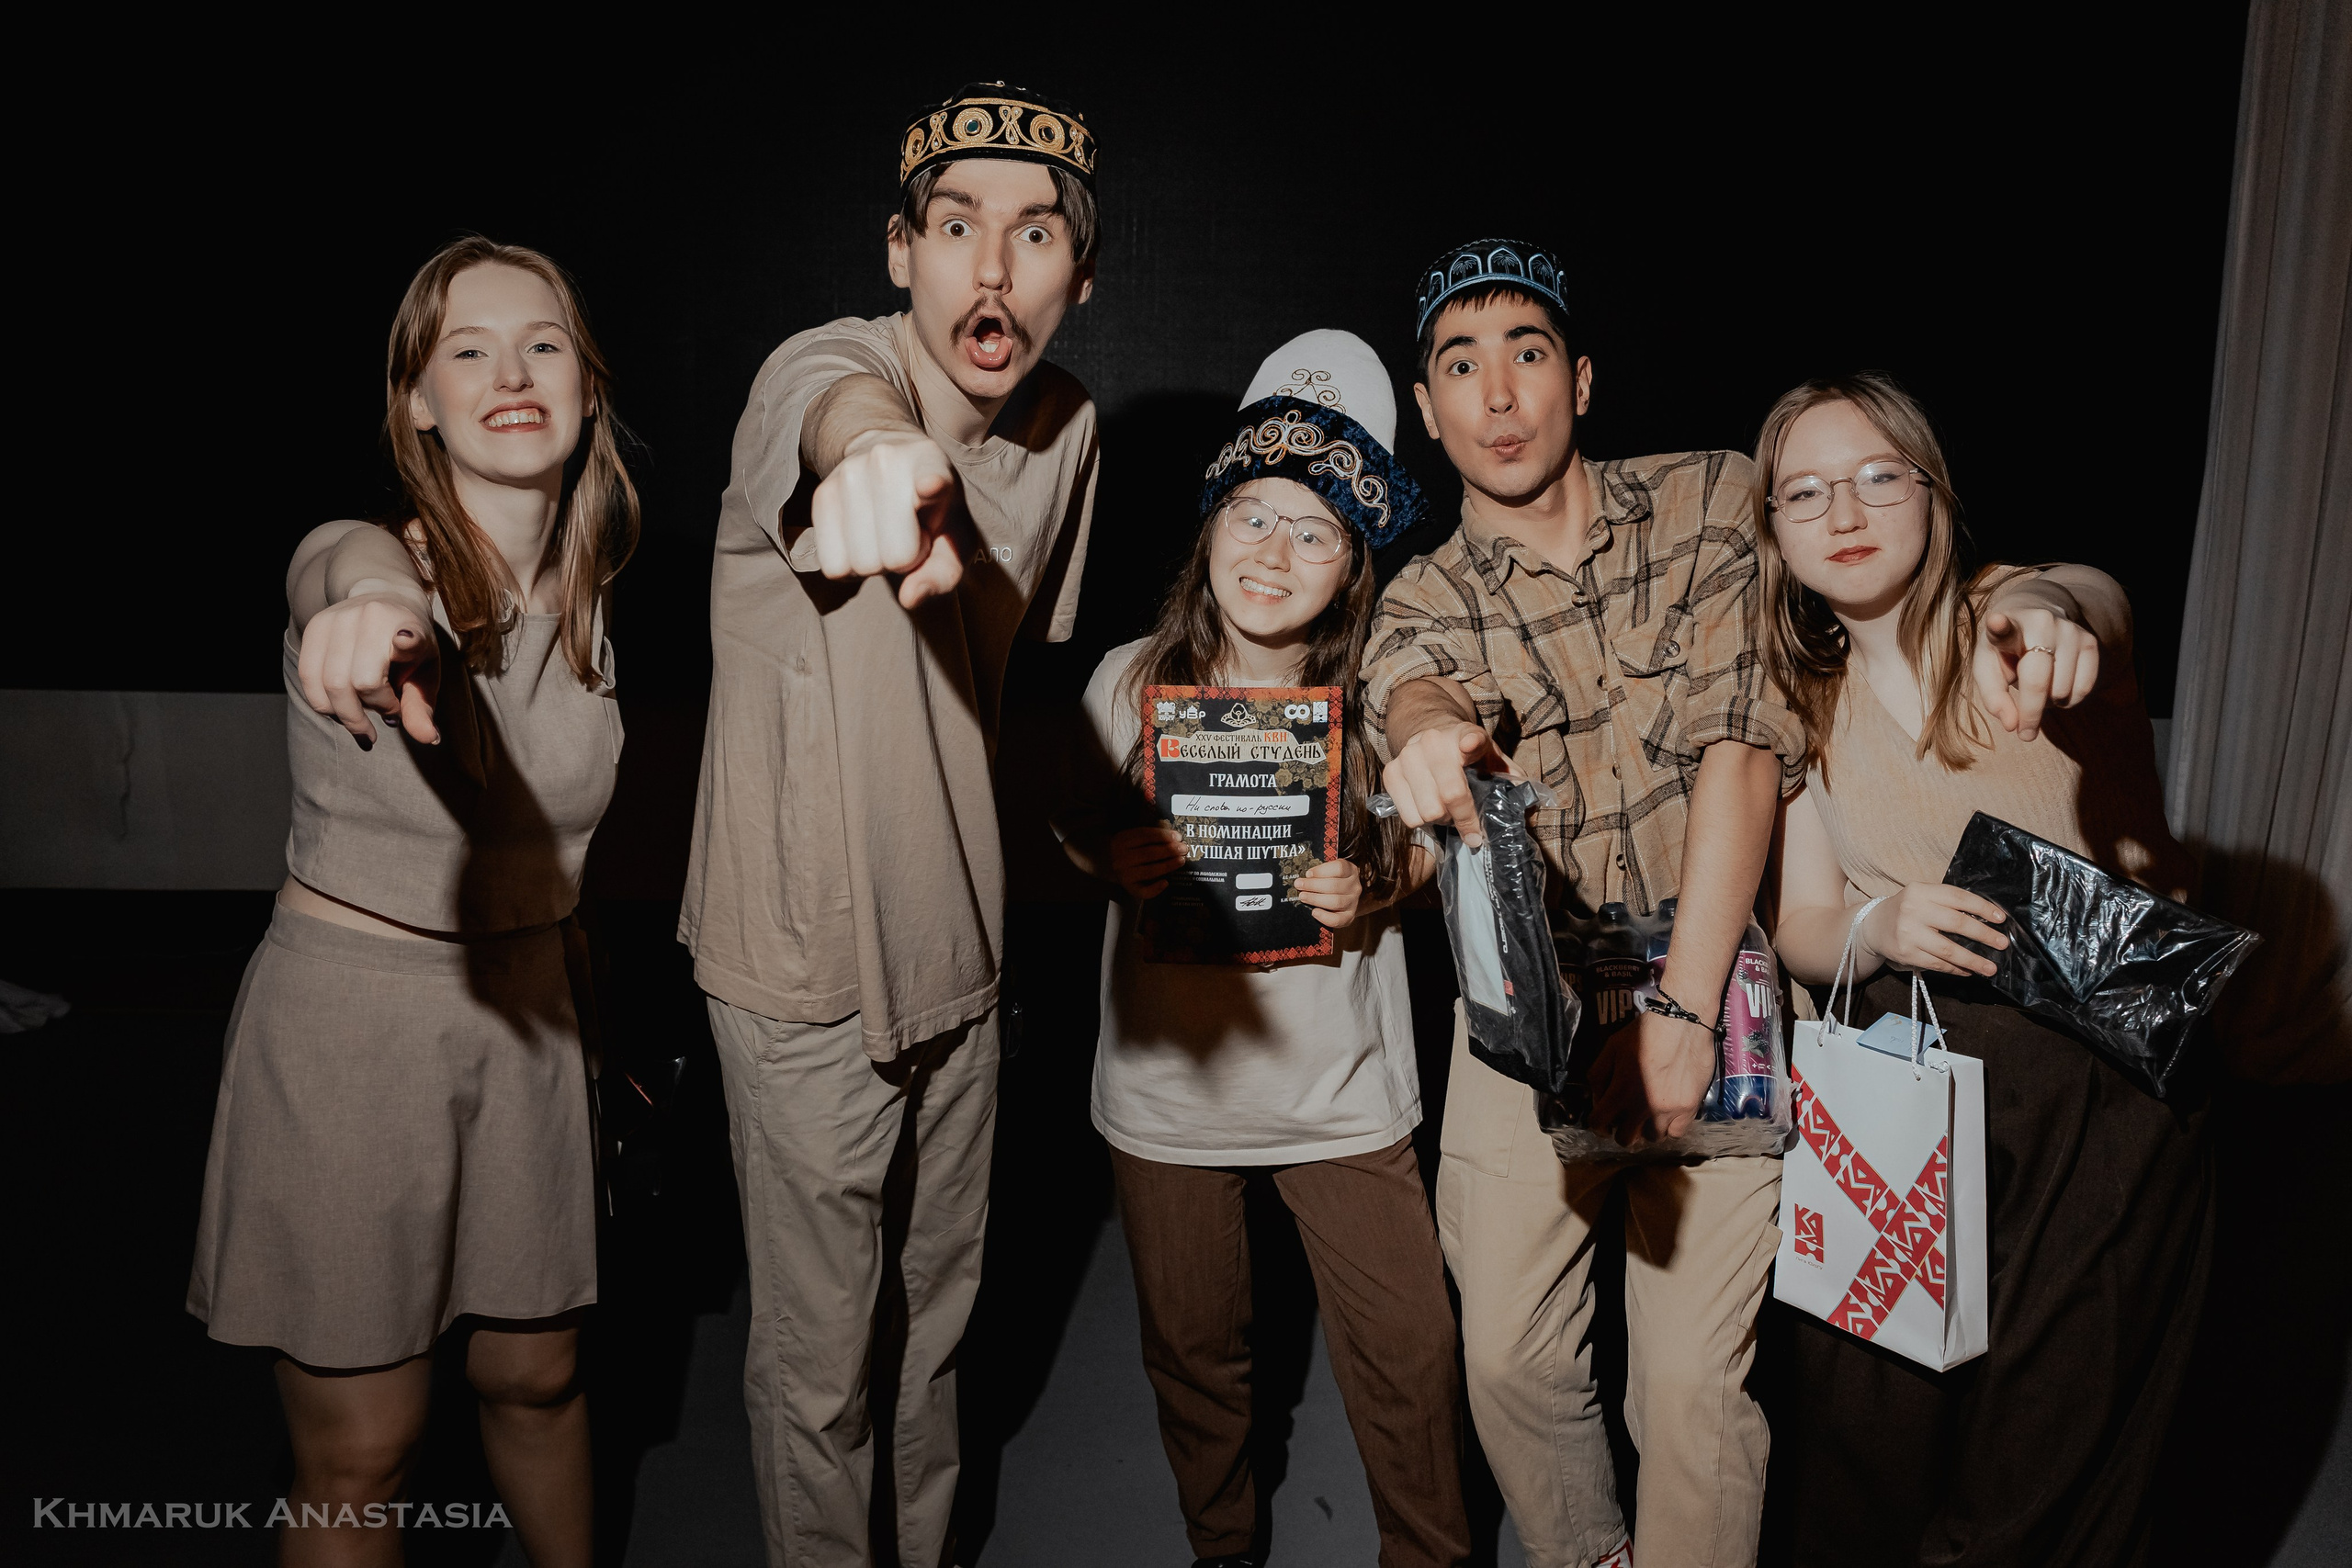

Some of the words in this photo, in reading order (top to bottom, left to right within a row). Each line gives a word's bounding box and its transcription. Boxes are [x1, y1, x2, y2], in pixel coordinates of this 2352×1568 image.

[1213, 734, 1262, 743] ФЕСТИВАЛЬ
[1263, 732, 1287, 742] КВН
[1160, 739, 1240, 760] ВЕСЕЛЫЙ
[1250, 744, 1321, 761] СТУДЕНЬ
[1209, 773, 1277, 788] ГРАМОТА
[1186, 796, 1200, 811] Ни
[1204, 802, 1230, 812] слова
[1186, 824, 1195, 838] В
[1199, 824, 1293, 840] НОМИНАЦИИ
[1247, 844, 1306, 861] ШУТКА»
[1595, 964, 1641, 973] BLACKBERRY
